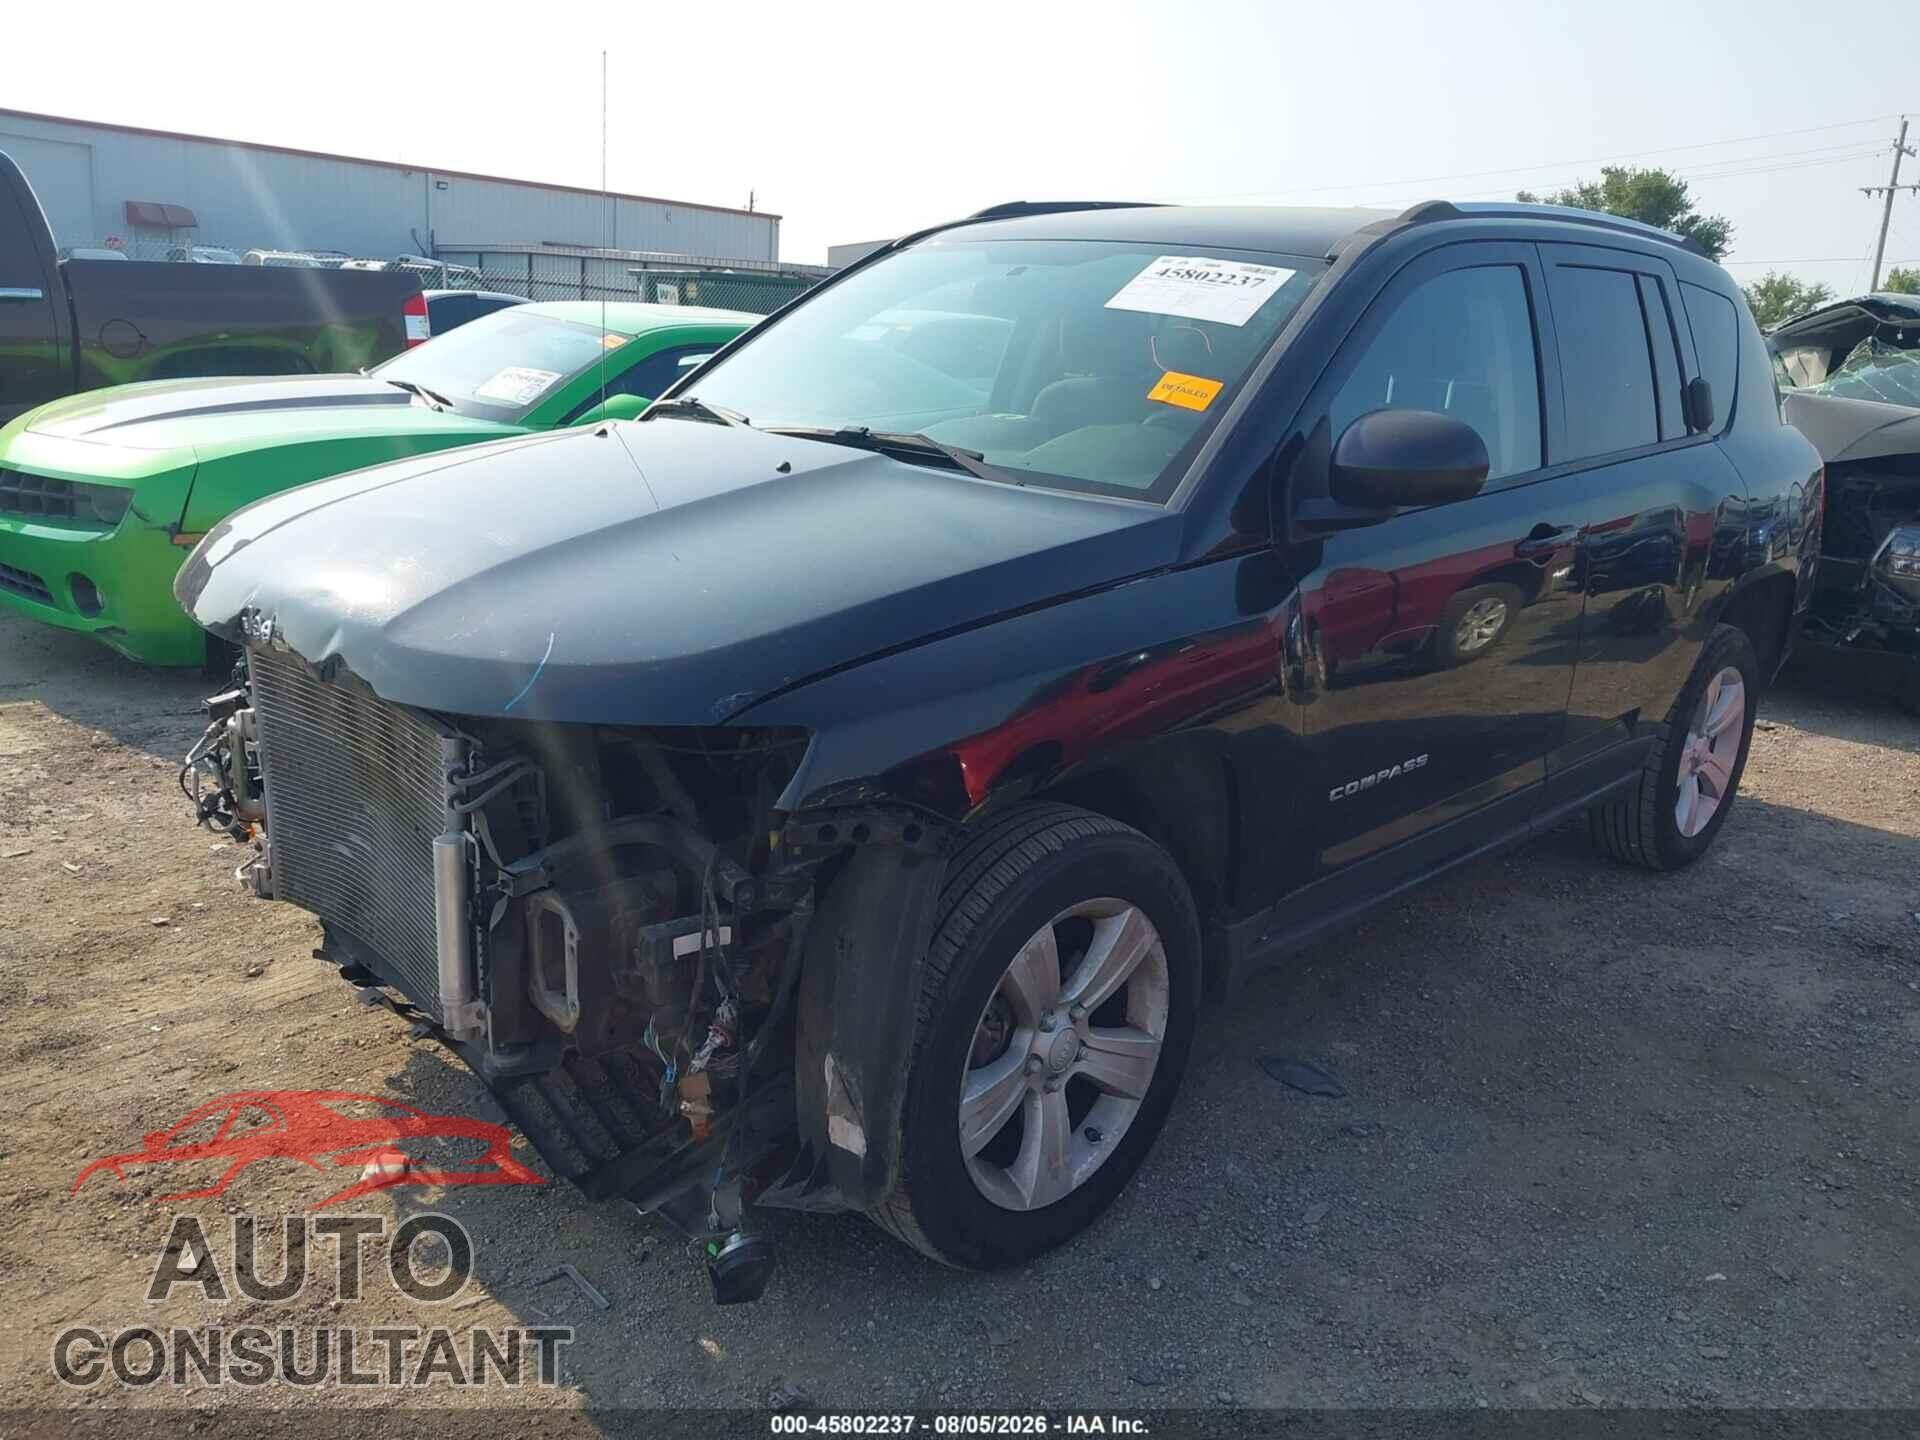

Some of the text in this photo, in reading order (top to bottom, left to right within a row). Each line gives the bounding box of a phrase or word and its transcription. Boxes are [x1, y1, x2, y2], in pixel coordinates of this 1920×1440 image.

[1154, 267, 1266, 289] 45802237
[1161, 383, 1209, 399] DETAILED
[1329, 753, 1429, 802] COMPASS
